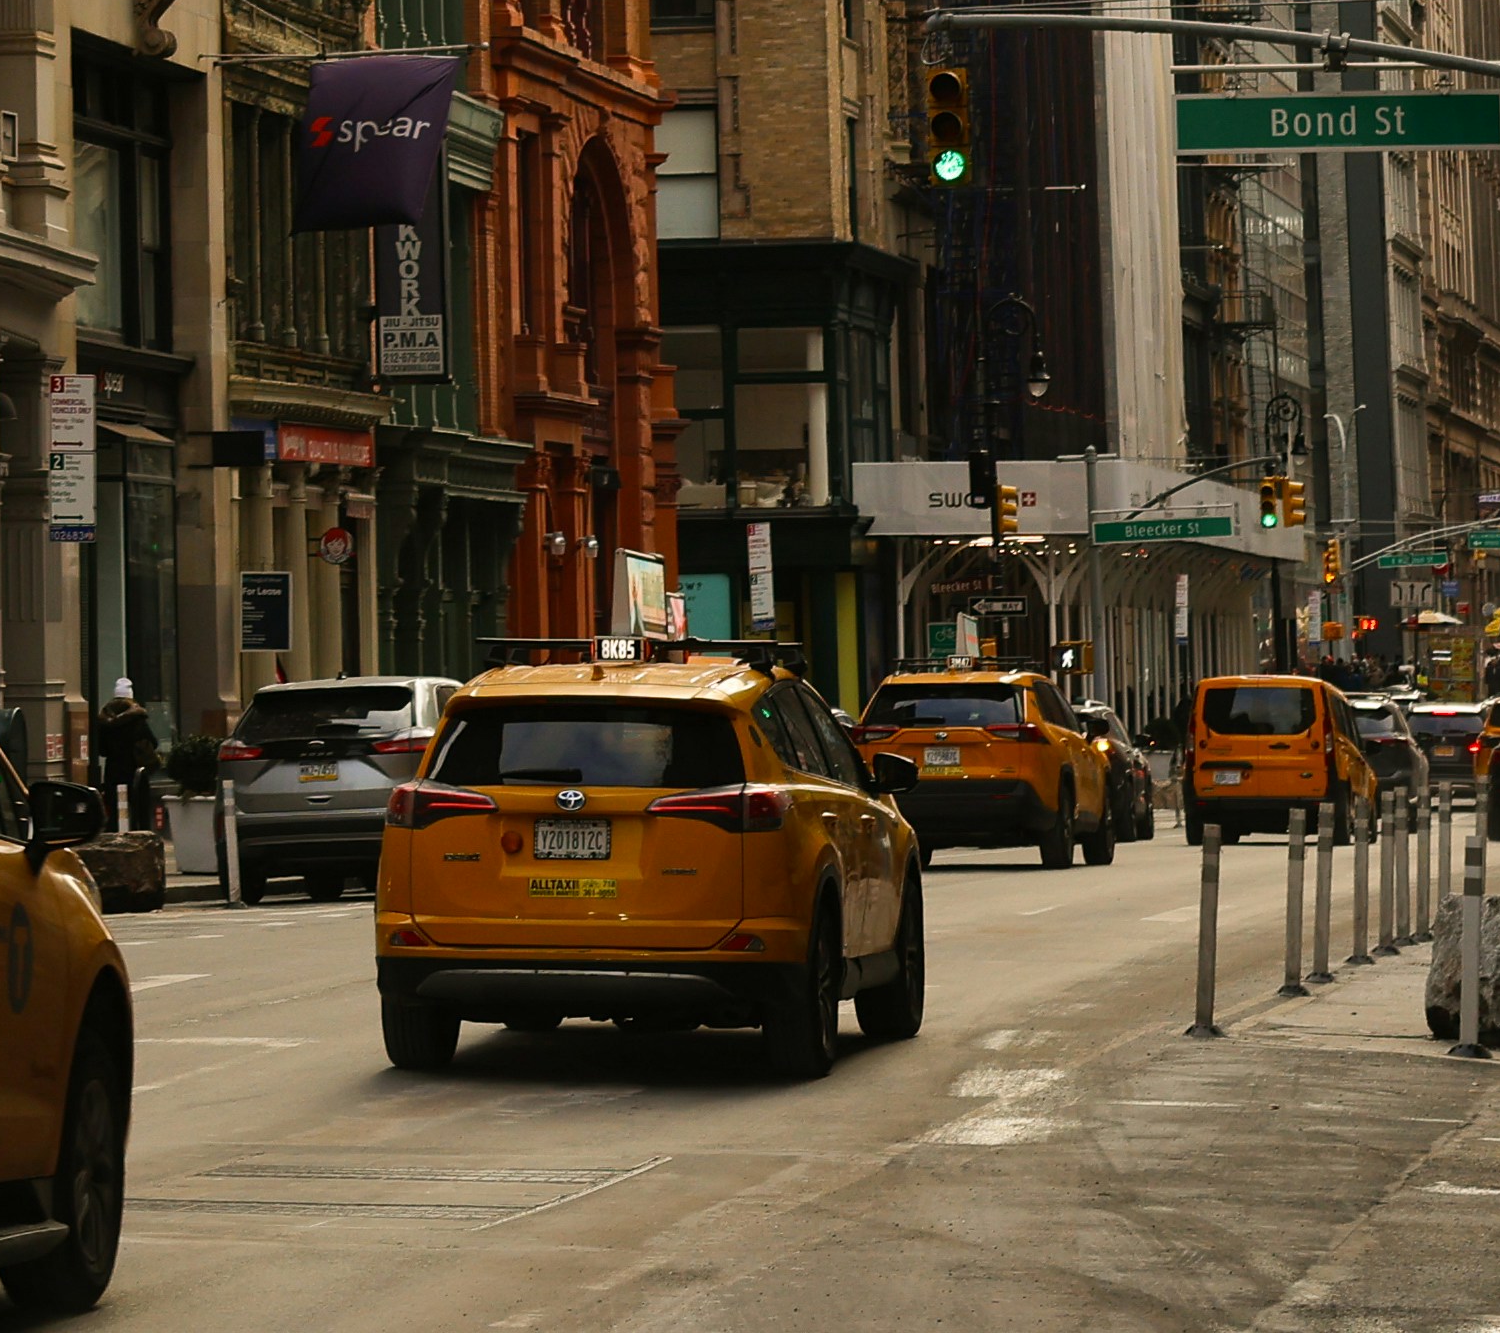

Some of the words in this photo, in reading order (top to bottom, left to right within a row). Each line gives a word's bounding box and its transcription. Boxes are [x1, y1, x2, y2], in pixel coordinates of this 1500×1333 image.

[1271, 105, 1357, 137] Bond
[1374, 106, 1406, 135] St
[383, 318, 400, 327] JIU
[409, 317, 439, 327] JITSU
[383, 332, 439, 348] P.M.A
[53, 377, 62, 392] 3
[53, 454, 62, 468] 2
[1124, 520, 1183, 537] Bleecker
[1189, 518, 1200, 534] St
[931, 581, 970, 594] Bleecker
[973, 579, 982, 591] St
[601, 639, 636, 660] 8K85
[541, 831, 603, 850] Y201812C
